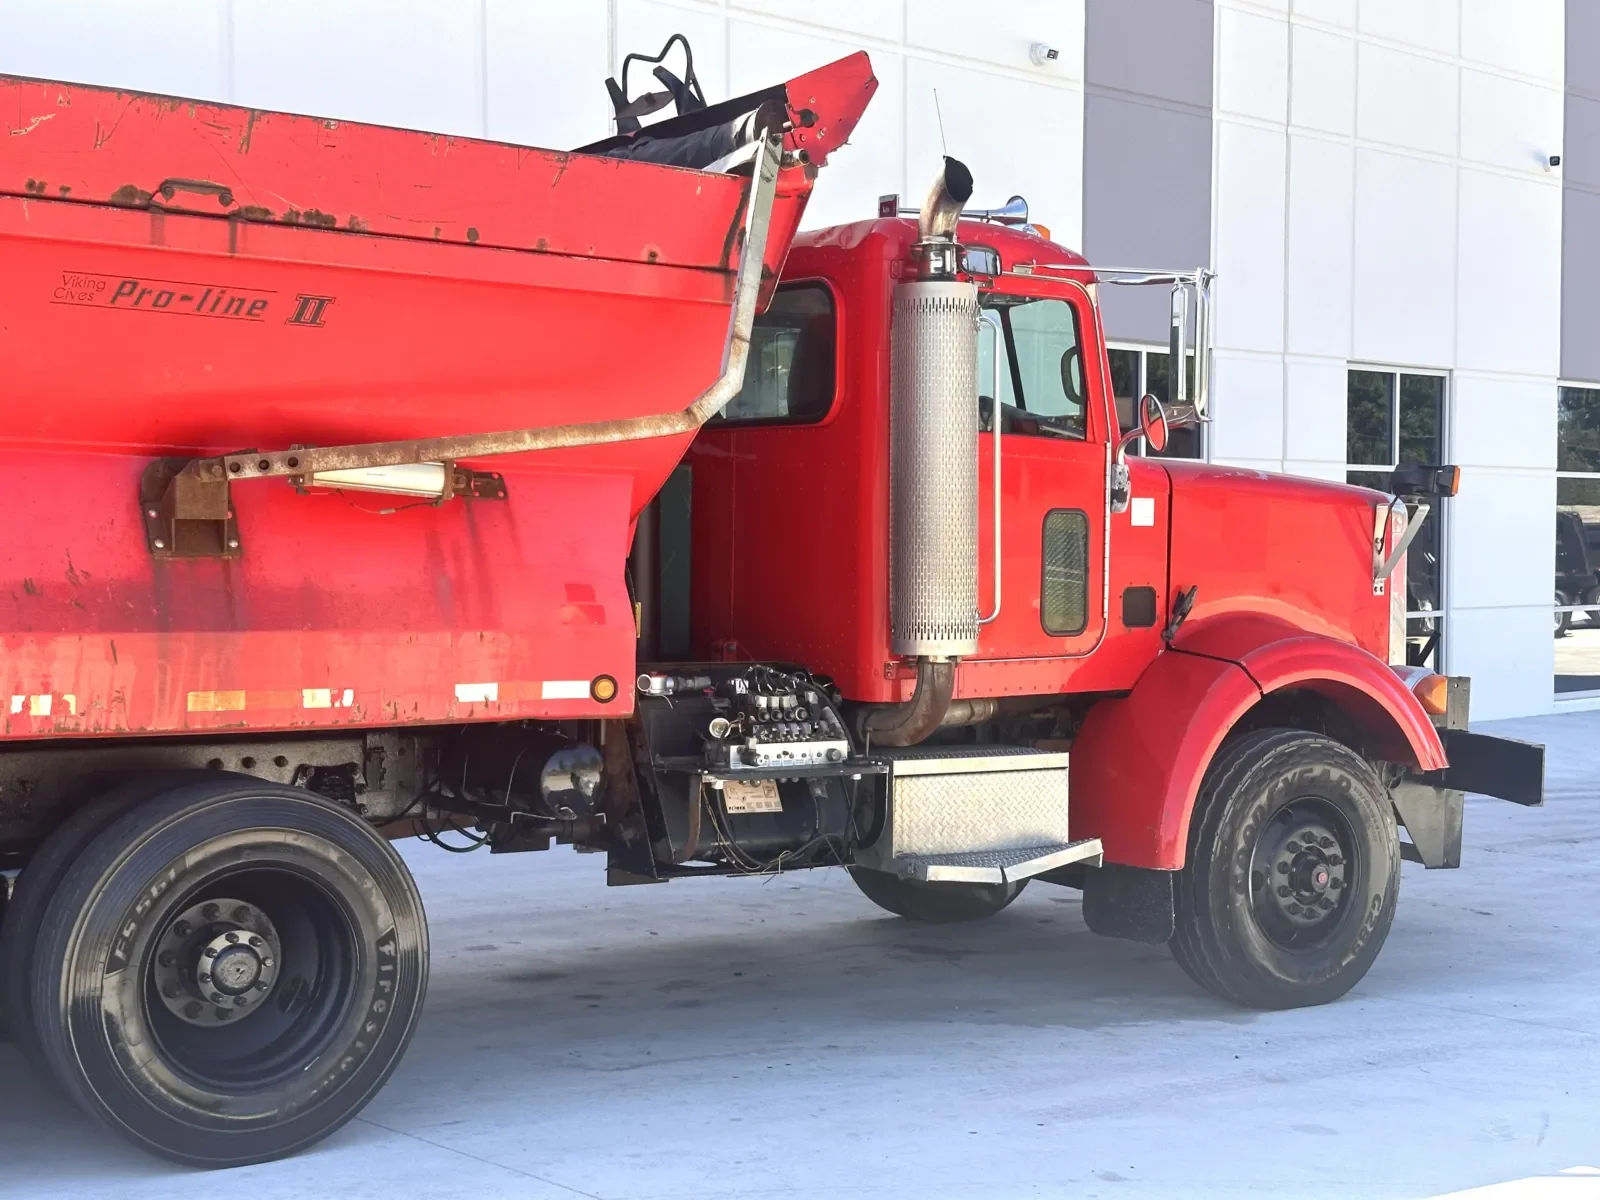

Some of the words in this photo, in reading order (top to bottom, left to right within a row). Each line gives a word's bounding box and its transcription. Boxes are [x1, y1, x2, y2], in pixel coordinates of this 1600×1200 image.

[61, 273, 106, 293] Viking
[53, 287, 95, 302] Cives
[108, 279, 269, 318] Pro-line
